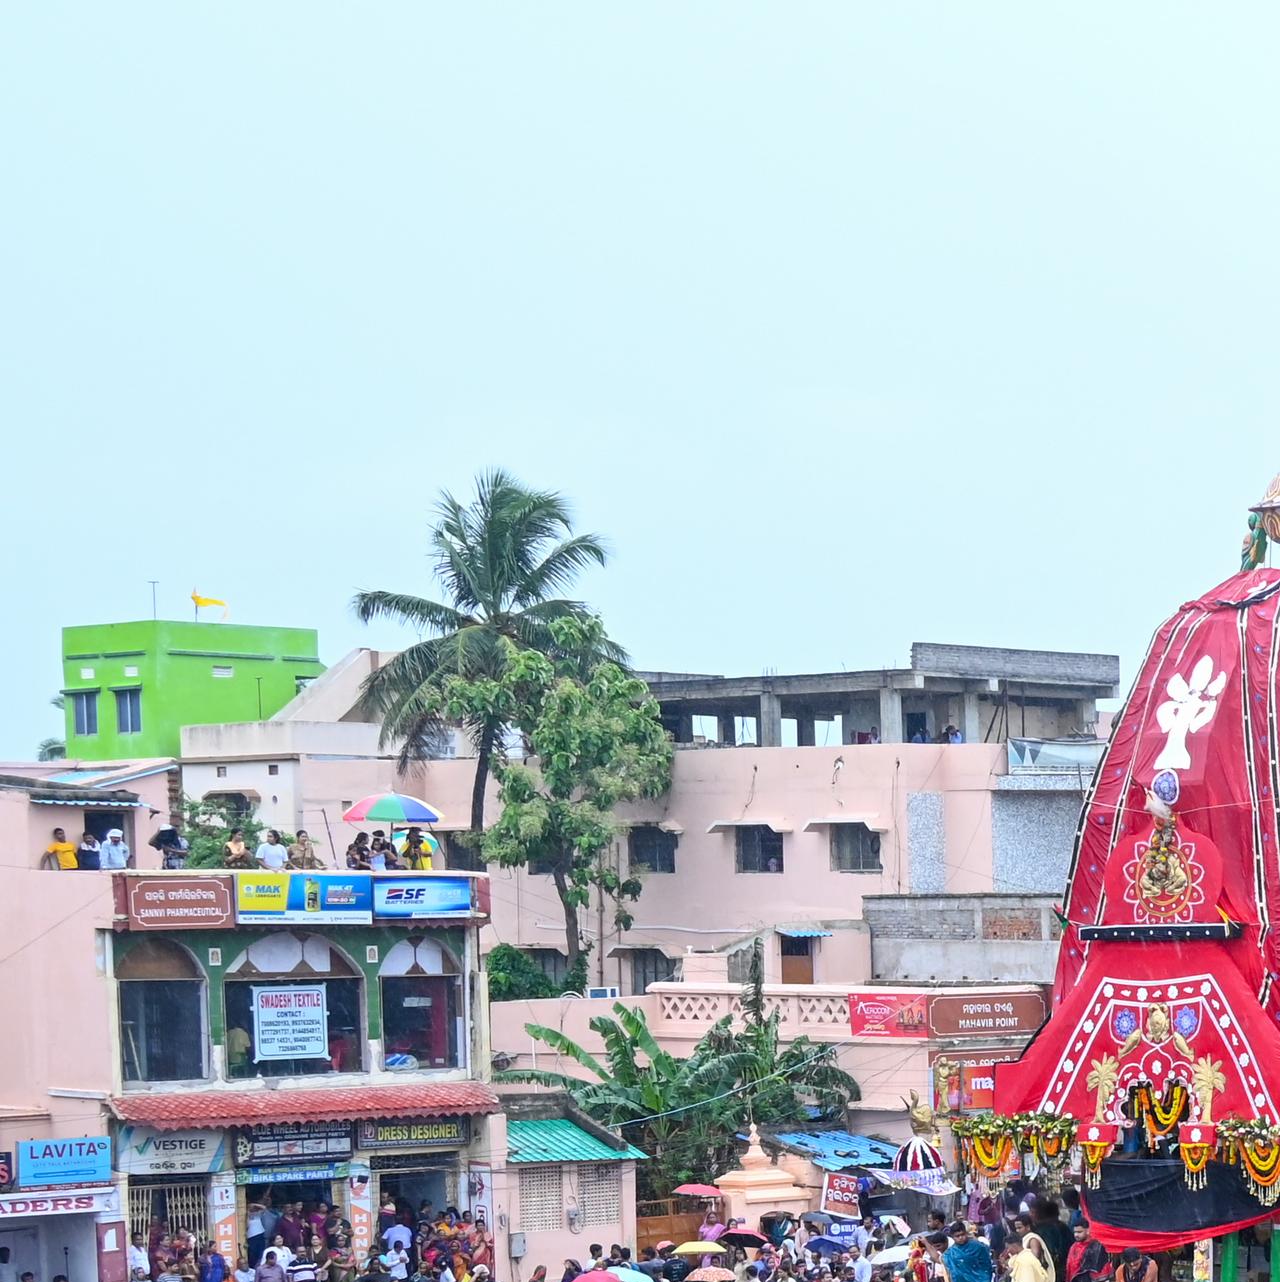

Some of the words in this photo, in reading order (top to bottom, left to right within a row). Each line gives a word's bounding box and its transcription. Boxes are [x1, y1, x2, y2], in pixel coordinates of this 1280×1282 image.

[255, 885, 281, 894] MAK
[403, 888, 426, 900] SF
[140, 908, 166, 918] SANNVI
[166, 907, 223, 918] PHARMACEUTICAL
[260, 993, 292, 1008] SWADESH
[293, 992, 320, 1008] TEXTILE
[276, 1010, 302, 1018] CONTACT
[958, 1018, 993, 1029] MAHAVIR
[995, 1017, 1018, 1028] POINT
[377, 1126, 409, 1141] DRESS
[410, 1123, 458, 1139] DESIGNER
[153, 1139, 206, 1150] VESTIGE
[29, 1142, 98, 1160] LAVITA
[253, 1172, 274, 1182] BIKE
[276, 1171, 304, 1181] SPARE
[306, 1169, 334, 1180] PARTS
